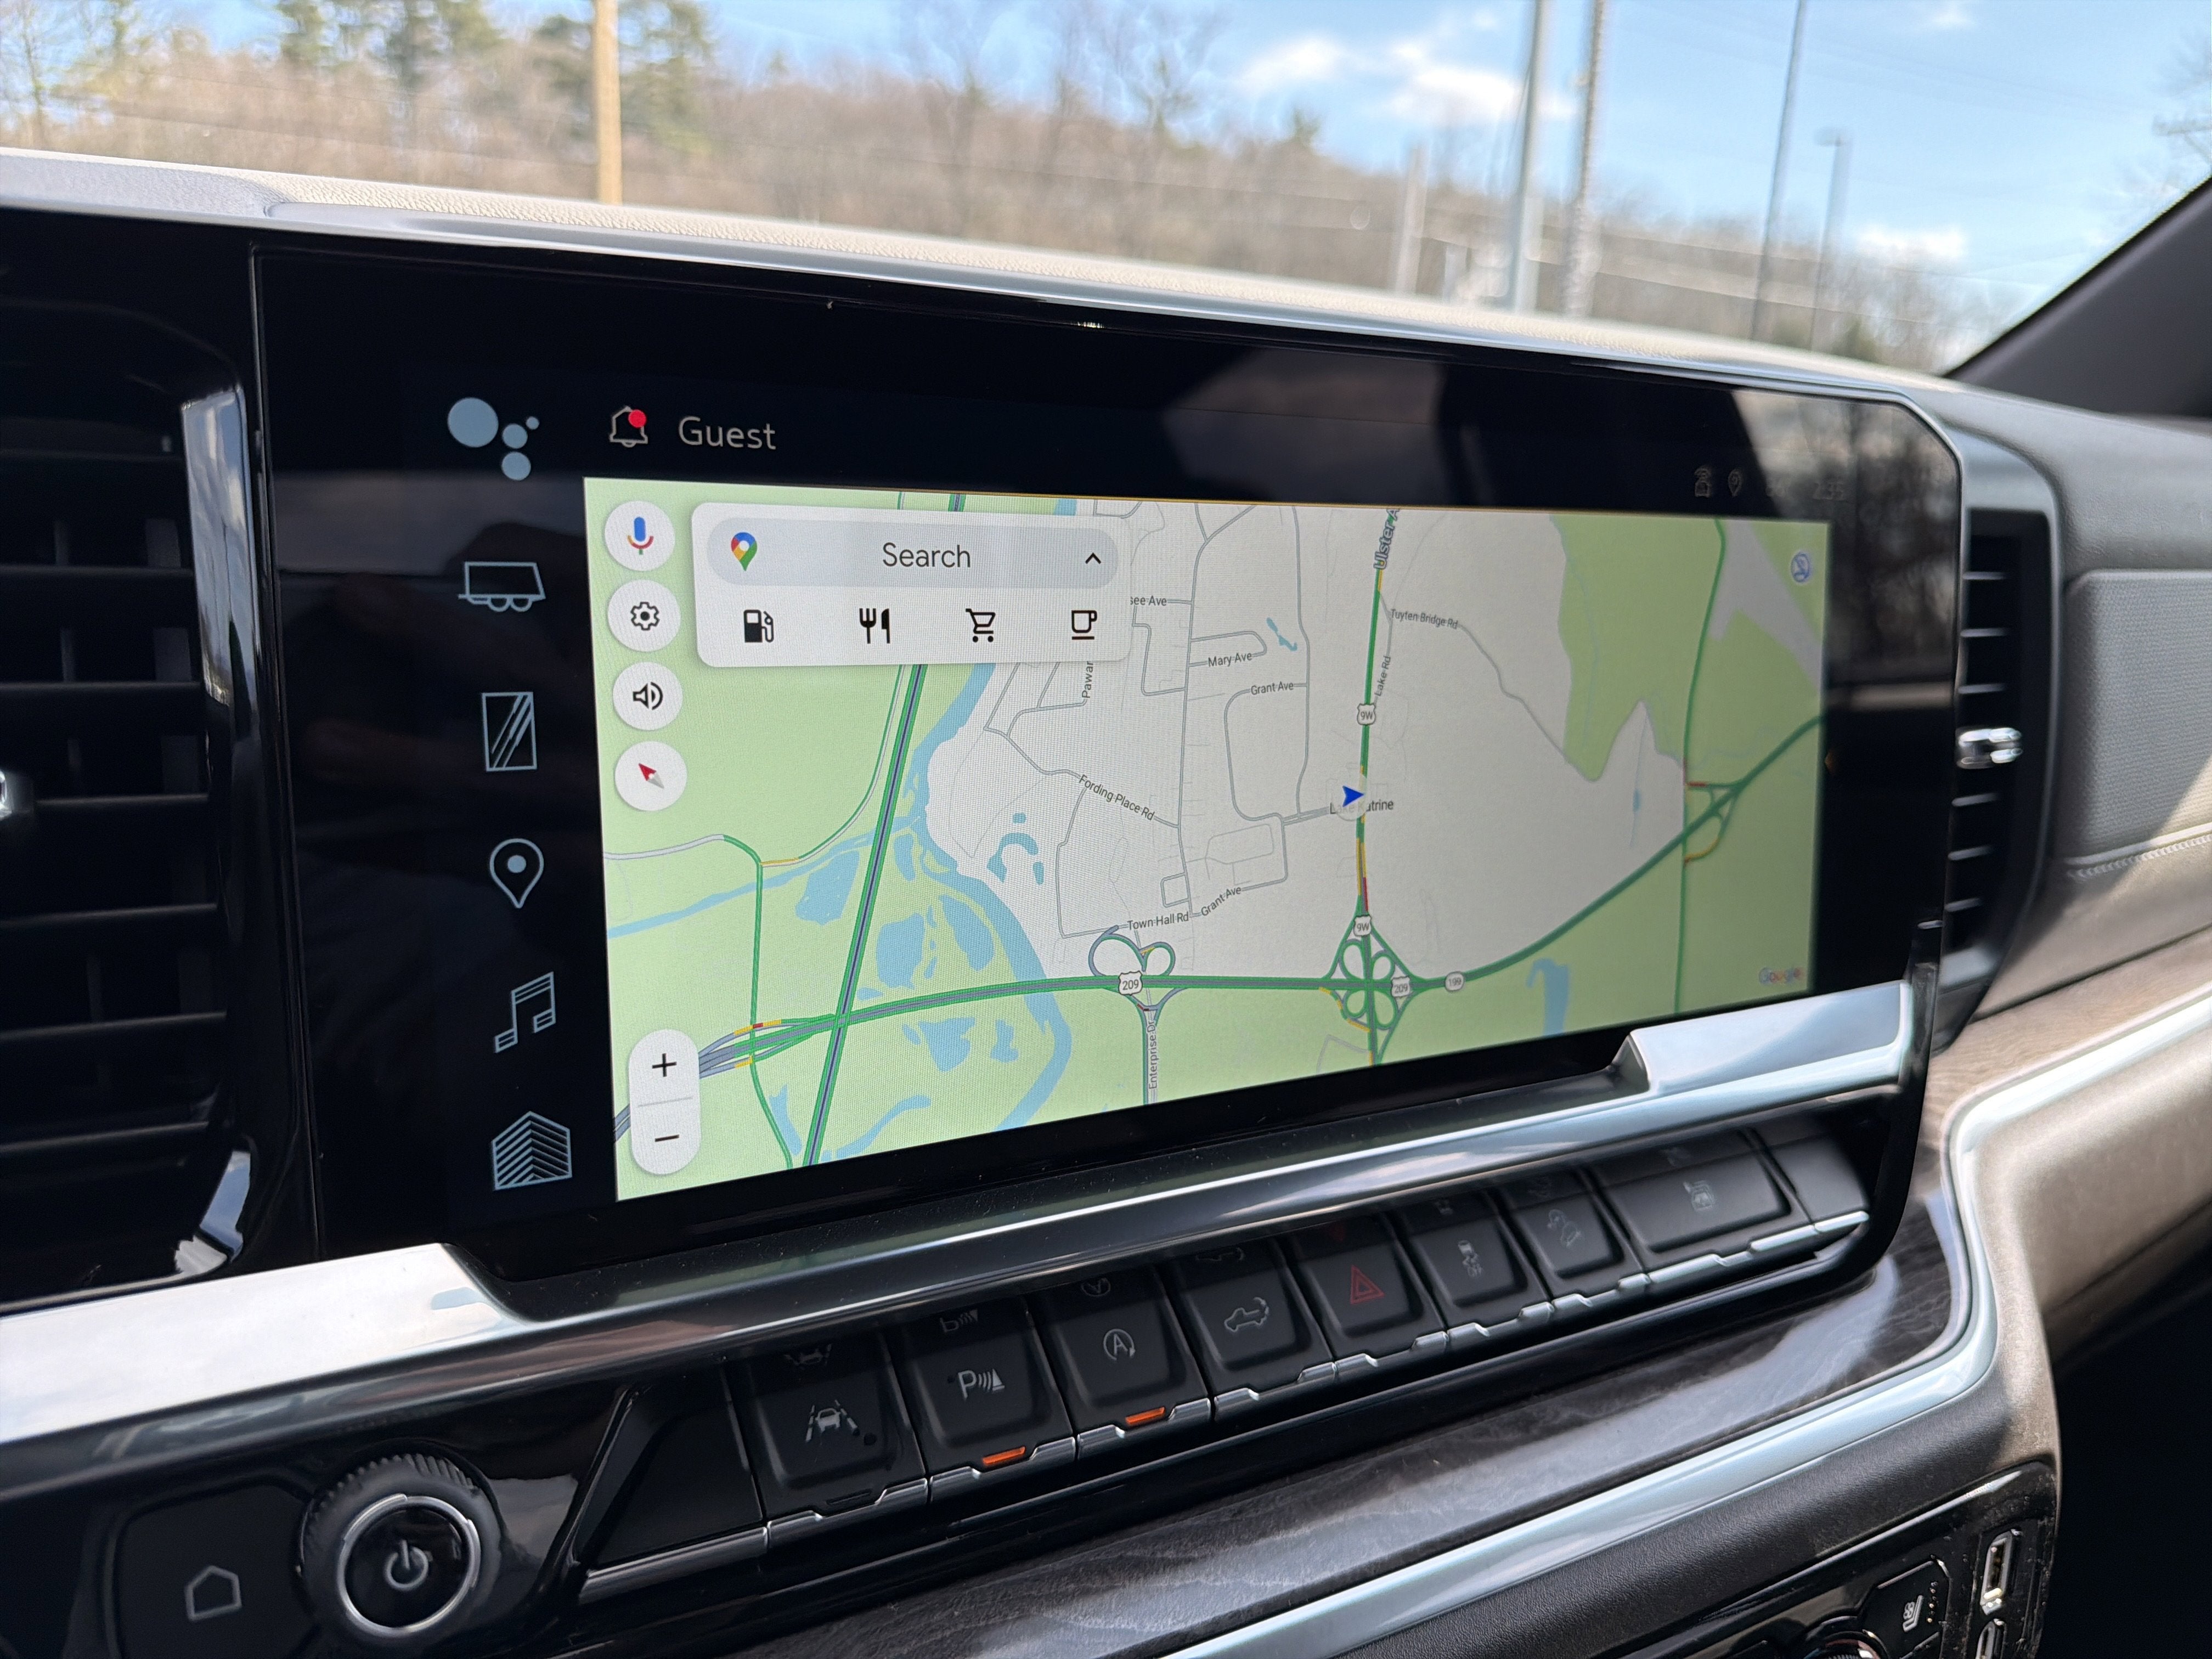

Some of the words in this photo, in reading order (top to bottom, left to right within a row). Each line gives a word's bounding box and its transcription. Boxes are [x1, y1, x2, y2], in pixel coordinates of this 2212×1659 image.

[678, 416, 776, 450] Guest
[1373, 520, 1395, 569] Ulster
[882, 542, 971, 568] Search
[1148, 595, 1167, 606] Ave
[1420, 612, 1446, 628] Bridge
[1447, 618, 1458, 629] Rd
[1208, 656, 1232, 667] Mary
[1234, 652, 1252, 663] Ave
[1374, 672, 1387, 696] Lake
[1381, 656, 1391, 670] Rd
[1251, 682, 1275, 695] Grant
[1278, 681, 1294, 691] Ave
[1361, 710, 1373, 720] 9W
[1079, 774, 1114, 802] Fording
[1115, 793, 1140, 813] Place
[1141, 806, 1155, 821] Rd
[1200, 894, 1225, 916] Grant
[1226, 887, 1242, 899] Ave
[1127, 919, 1153, 930] Town
[1156, 913, 1175, 926] Hall
[1177, 911, 1189, 923] Rd
[1356, 922, 1369, 932] 9W
[1122, 979, 1139, 990] 209
[1394, 983, 1408, 994] 209
[1448, 977, 1462, 986] 199
[1147, 1020, 1156, 1032] Dr
[1148, 1034, 1159, 1090] Enterprise
